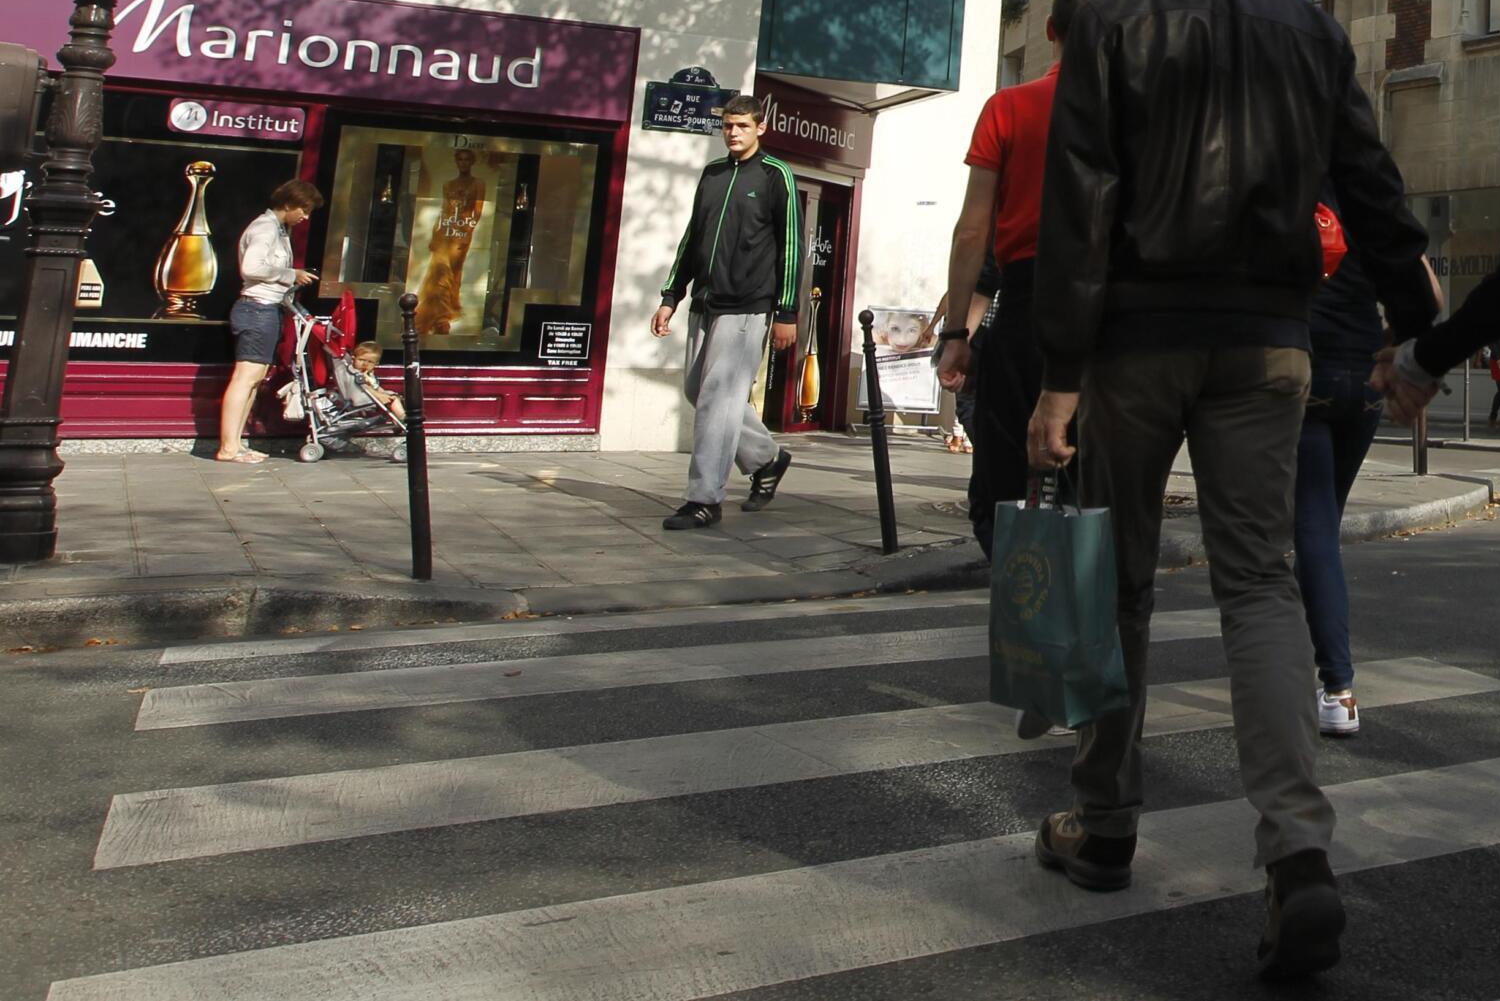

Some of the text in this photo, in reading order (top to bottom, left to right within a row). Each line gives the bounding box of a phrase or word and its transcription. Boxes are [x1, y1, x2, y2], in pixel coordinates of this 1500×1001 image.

[686, 95, 701, 103] RUE
[212, 110, 299, 133] Institut
[761, 92, 856, 151] Marionnaud
[69, 332, 148, 348] IMANCHE
